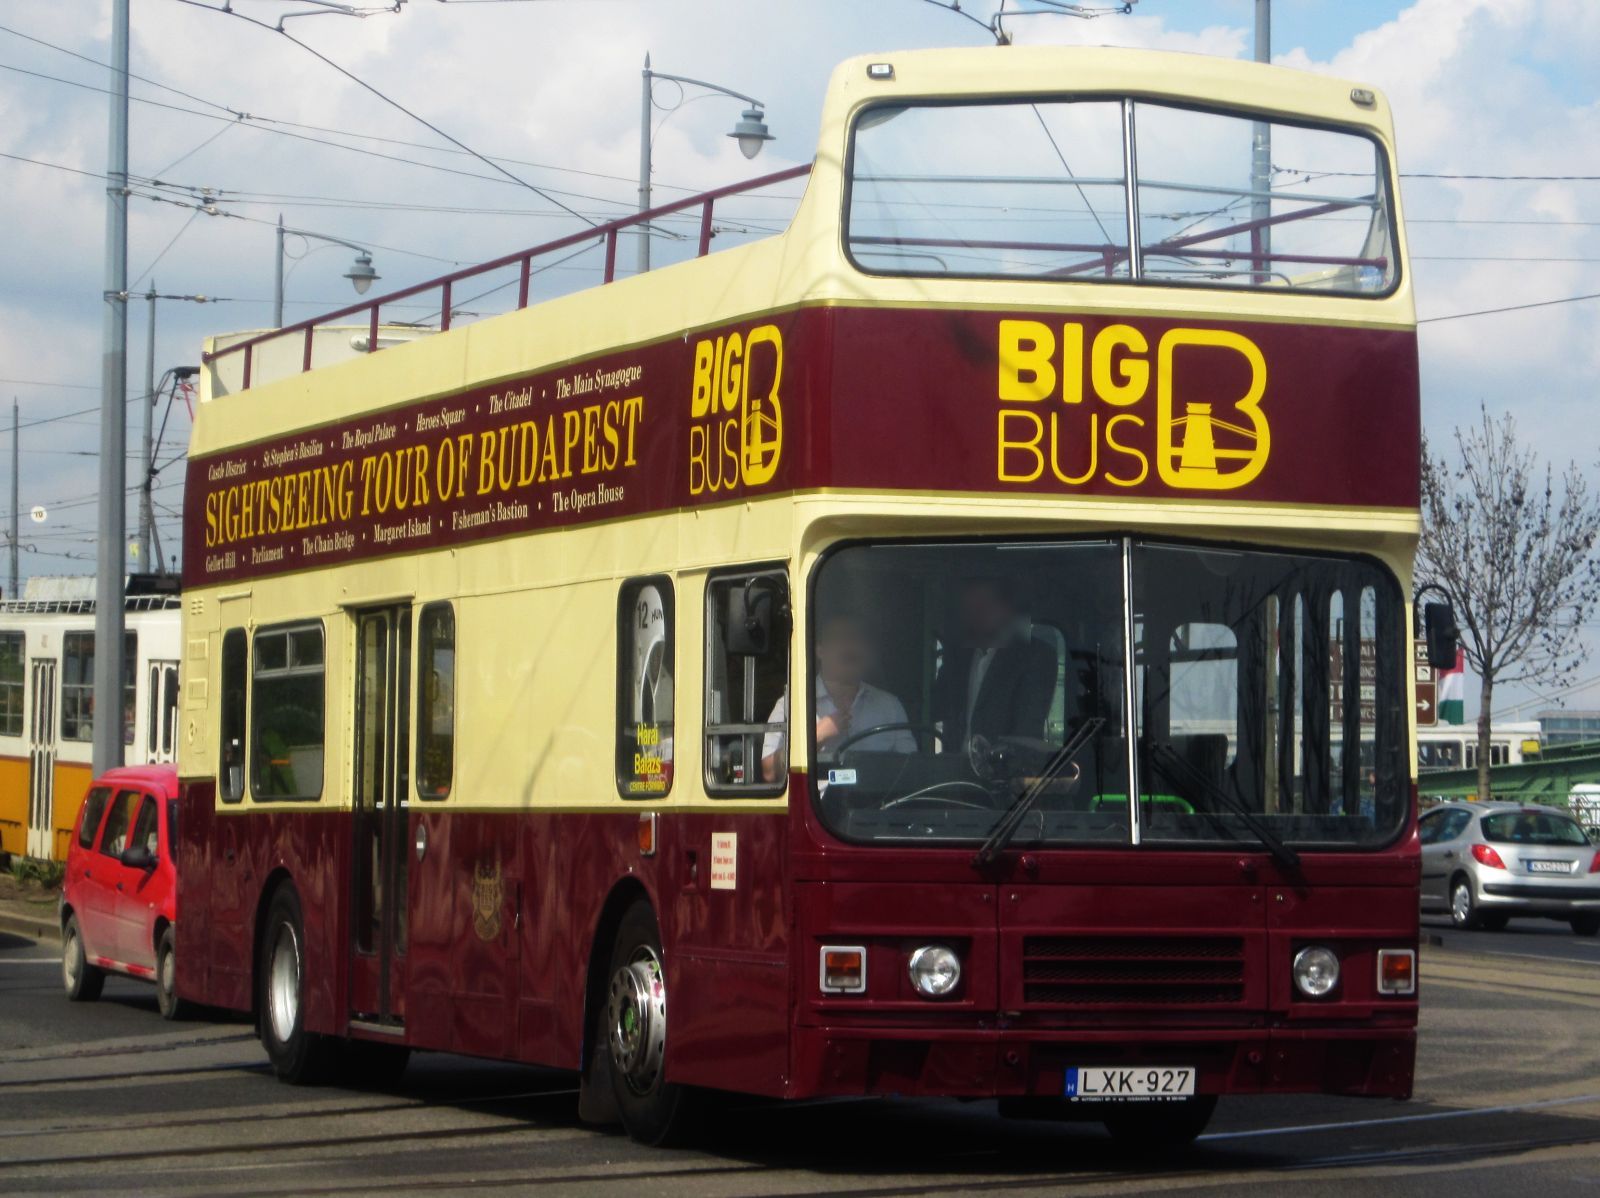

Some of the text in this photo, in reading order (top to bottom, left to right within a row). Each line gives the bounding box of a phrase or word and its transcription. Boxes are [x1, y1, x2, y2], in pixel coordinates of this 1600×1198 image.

[692, 332, 742, 418] BIG
[999, 319, 1150, 406] BIG
[556, 364, 642, 399] The Main Synagogue
[489, 386, 532, 415] The Citadel
[416, 407, 466, 432] Heroes Square
[342, 424, 397, 450] The Royal Palace
[998, 410, 1149, 487] BUS
[270, 445, 298, 469] Stephen's
[299, 438, 323, 460] Basilica
[690, 418, 738, 495] BUS
[206, 396, 643, 547] SIGHTSEEING TOUR OF BUDAPEST
[208, 460, 247, 480] Castle District
[552, 483, 624, 513] The Opera House
[452, 500, 528, 531] Fisherman's Bastion
[302, 531, 355, 555] The Chain Bridge
[374, 518, 431, 546] Margaret Island
[225, 552, 236, 569] Hill
[251, 546, 284, 565] Parliament
[637, 601, 648, 629] 12
[1083, 1069, 1190, 1094] LXK-927
